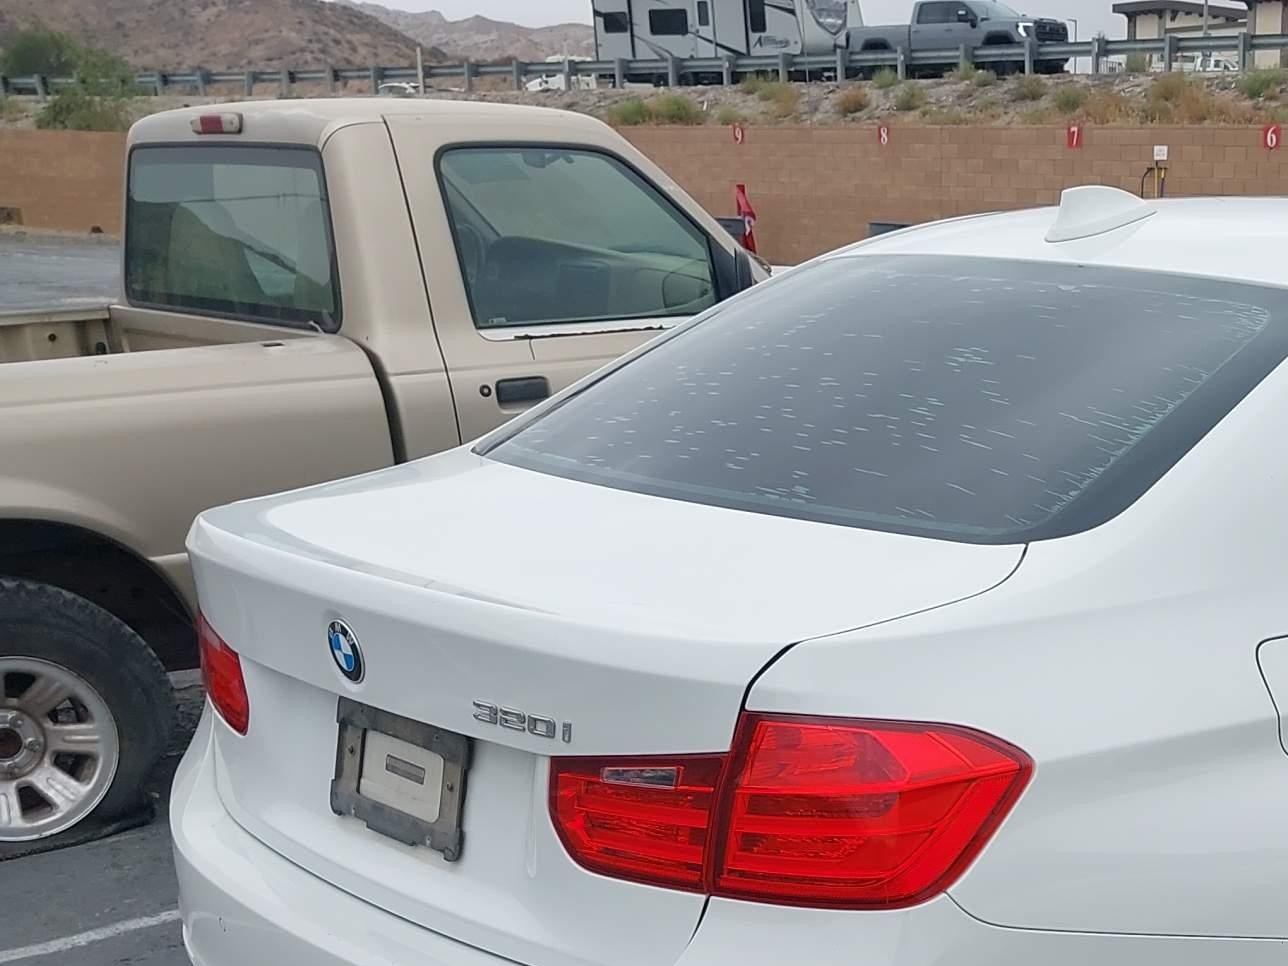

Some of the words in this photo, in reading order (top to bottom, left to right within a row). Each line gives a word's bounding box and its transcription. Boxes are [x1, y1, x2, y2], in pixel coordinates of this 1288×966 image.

[735, 127, 742, 144] 9
[881, 127, 888, 145] 8
[1070, 126, 1078, 146] 7
[1266, 127, 1276, 147] 6
[472, 699, 572, 743] 320i
